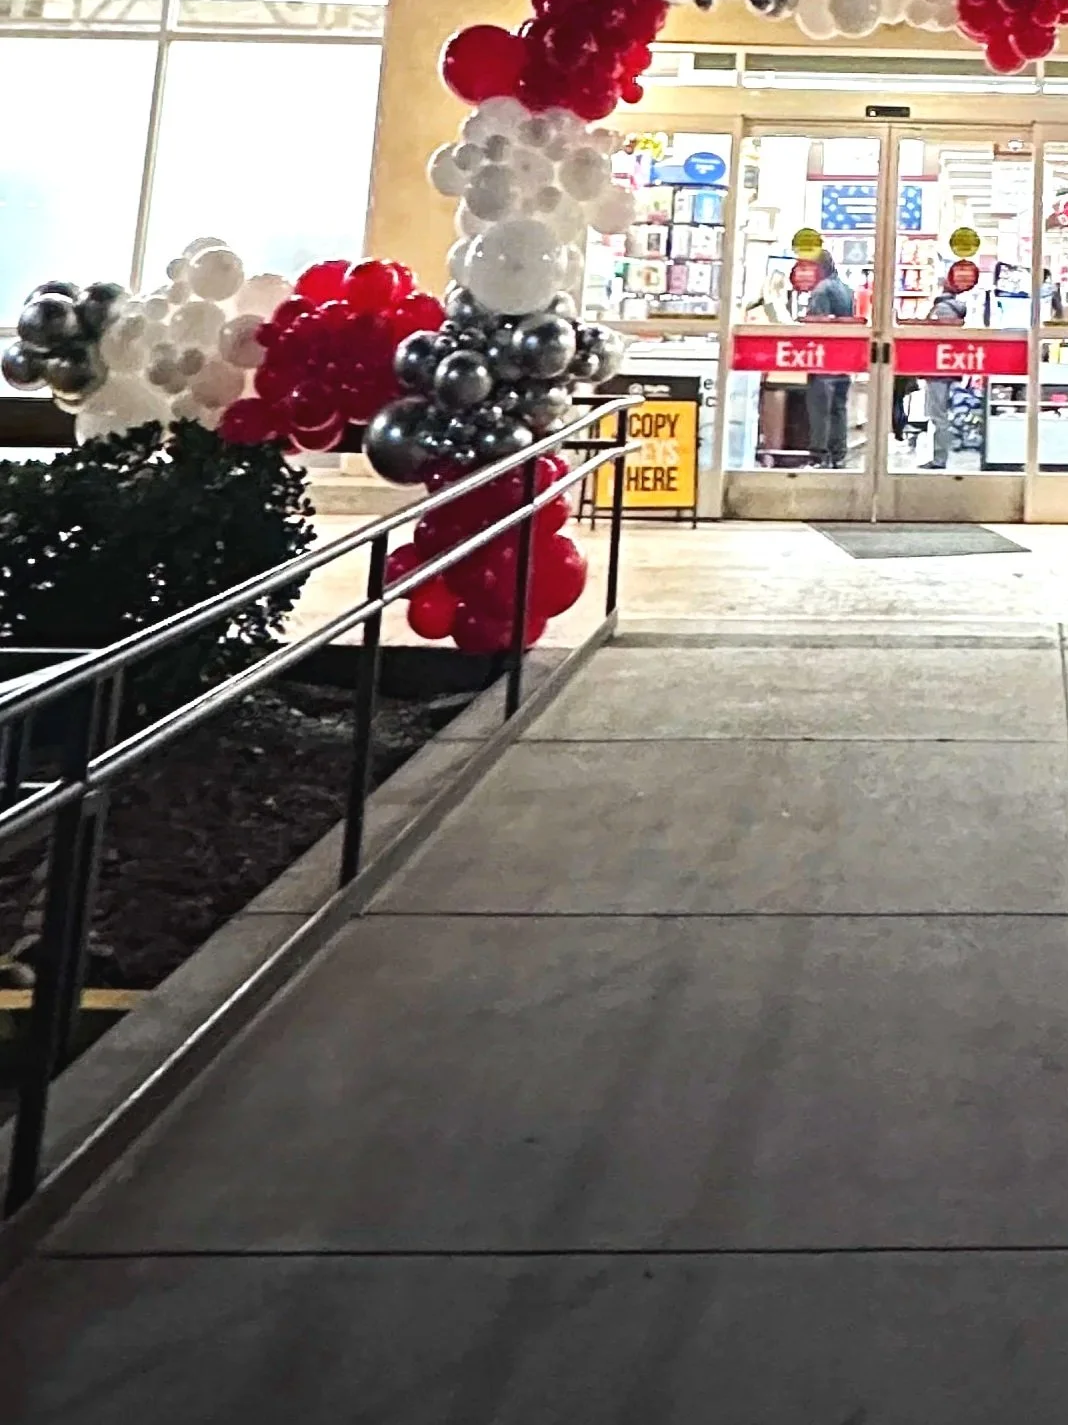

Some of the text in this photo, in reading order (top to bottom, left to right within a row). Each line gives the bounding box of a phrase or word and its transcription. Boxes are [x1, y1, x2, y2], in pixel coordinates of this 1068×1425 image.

[776, 341, 825, 368] Exit
[936, 343, 986, 371] Exit
[627, 413, 680, 438] COPY
[625, 466, 679, 492] HERE
